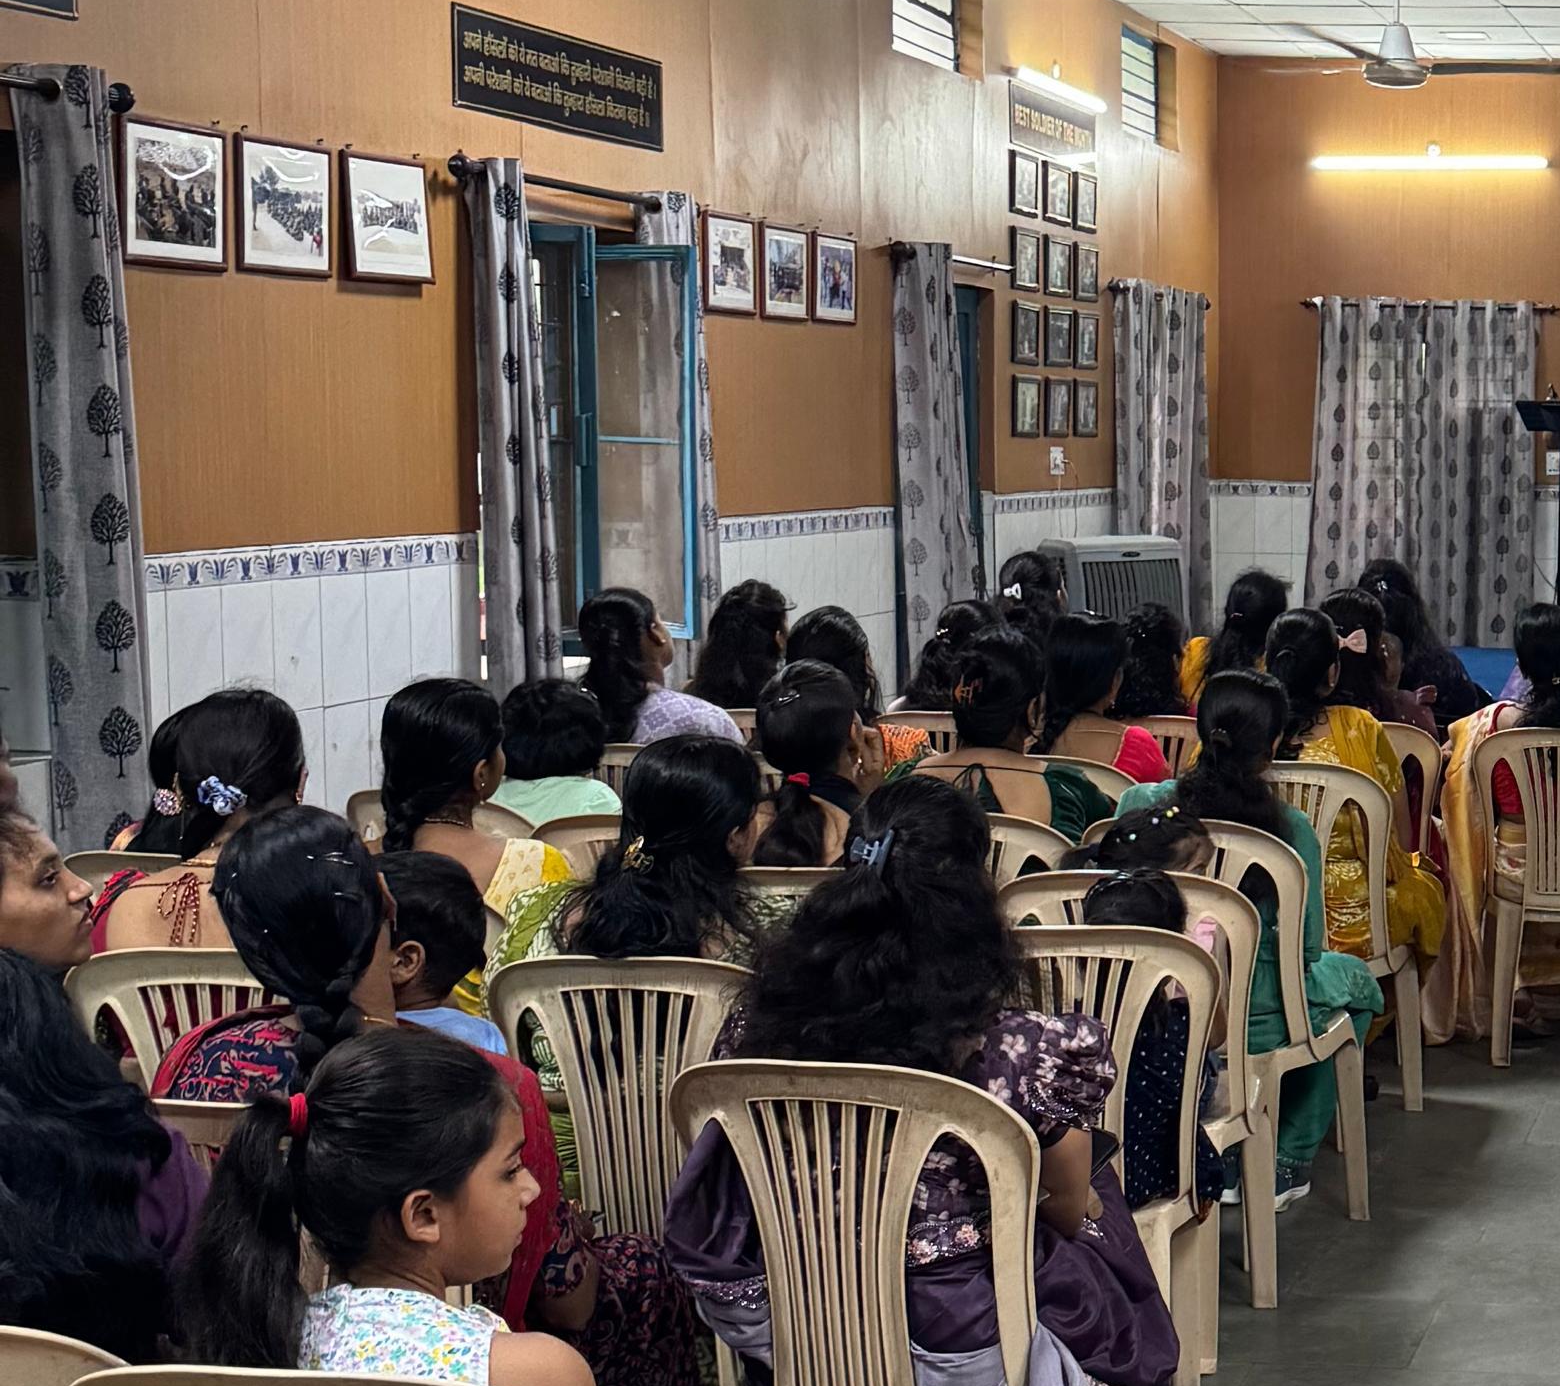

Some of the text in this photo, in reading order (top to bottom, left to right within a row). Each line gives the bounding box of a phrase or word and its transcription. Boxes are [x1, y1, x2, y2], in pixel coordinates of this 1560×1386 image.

[463, 29, 483, 53] अपने
[508, 39, 519, 63] को
[518, 42, 526, 65] ये
[526, 47, 539, 68] मत
[560, 52, 571, 76] कि
[463, 61, 485, 86] अपनी
[485, 66, 512, 94] परेशानी
[513, 73, 524, 97] को
[523, 75, 531, 99] ये
[553, 81, 563, 106] कि
[1014, 103, 1031, 129] BEST
[1031, 109, 1055, 138] SOLDIER
[1055, 118, 1063, 140] OF
[1063, 121, 1074, 145] THE
